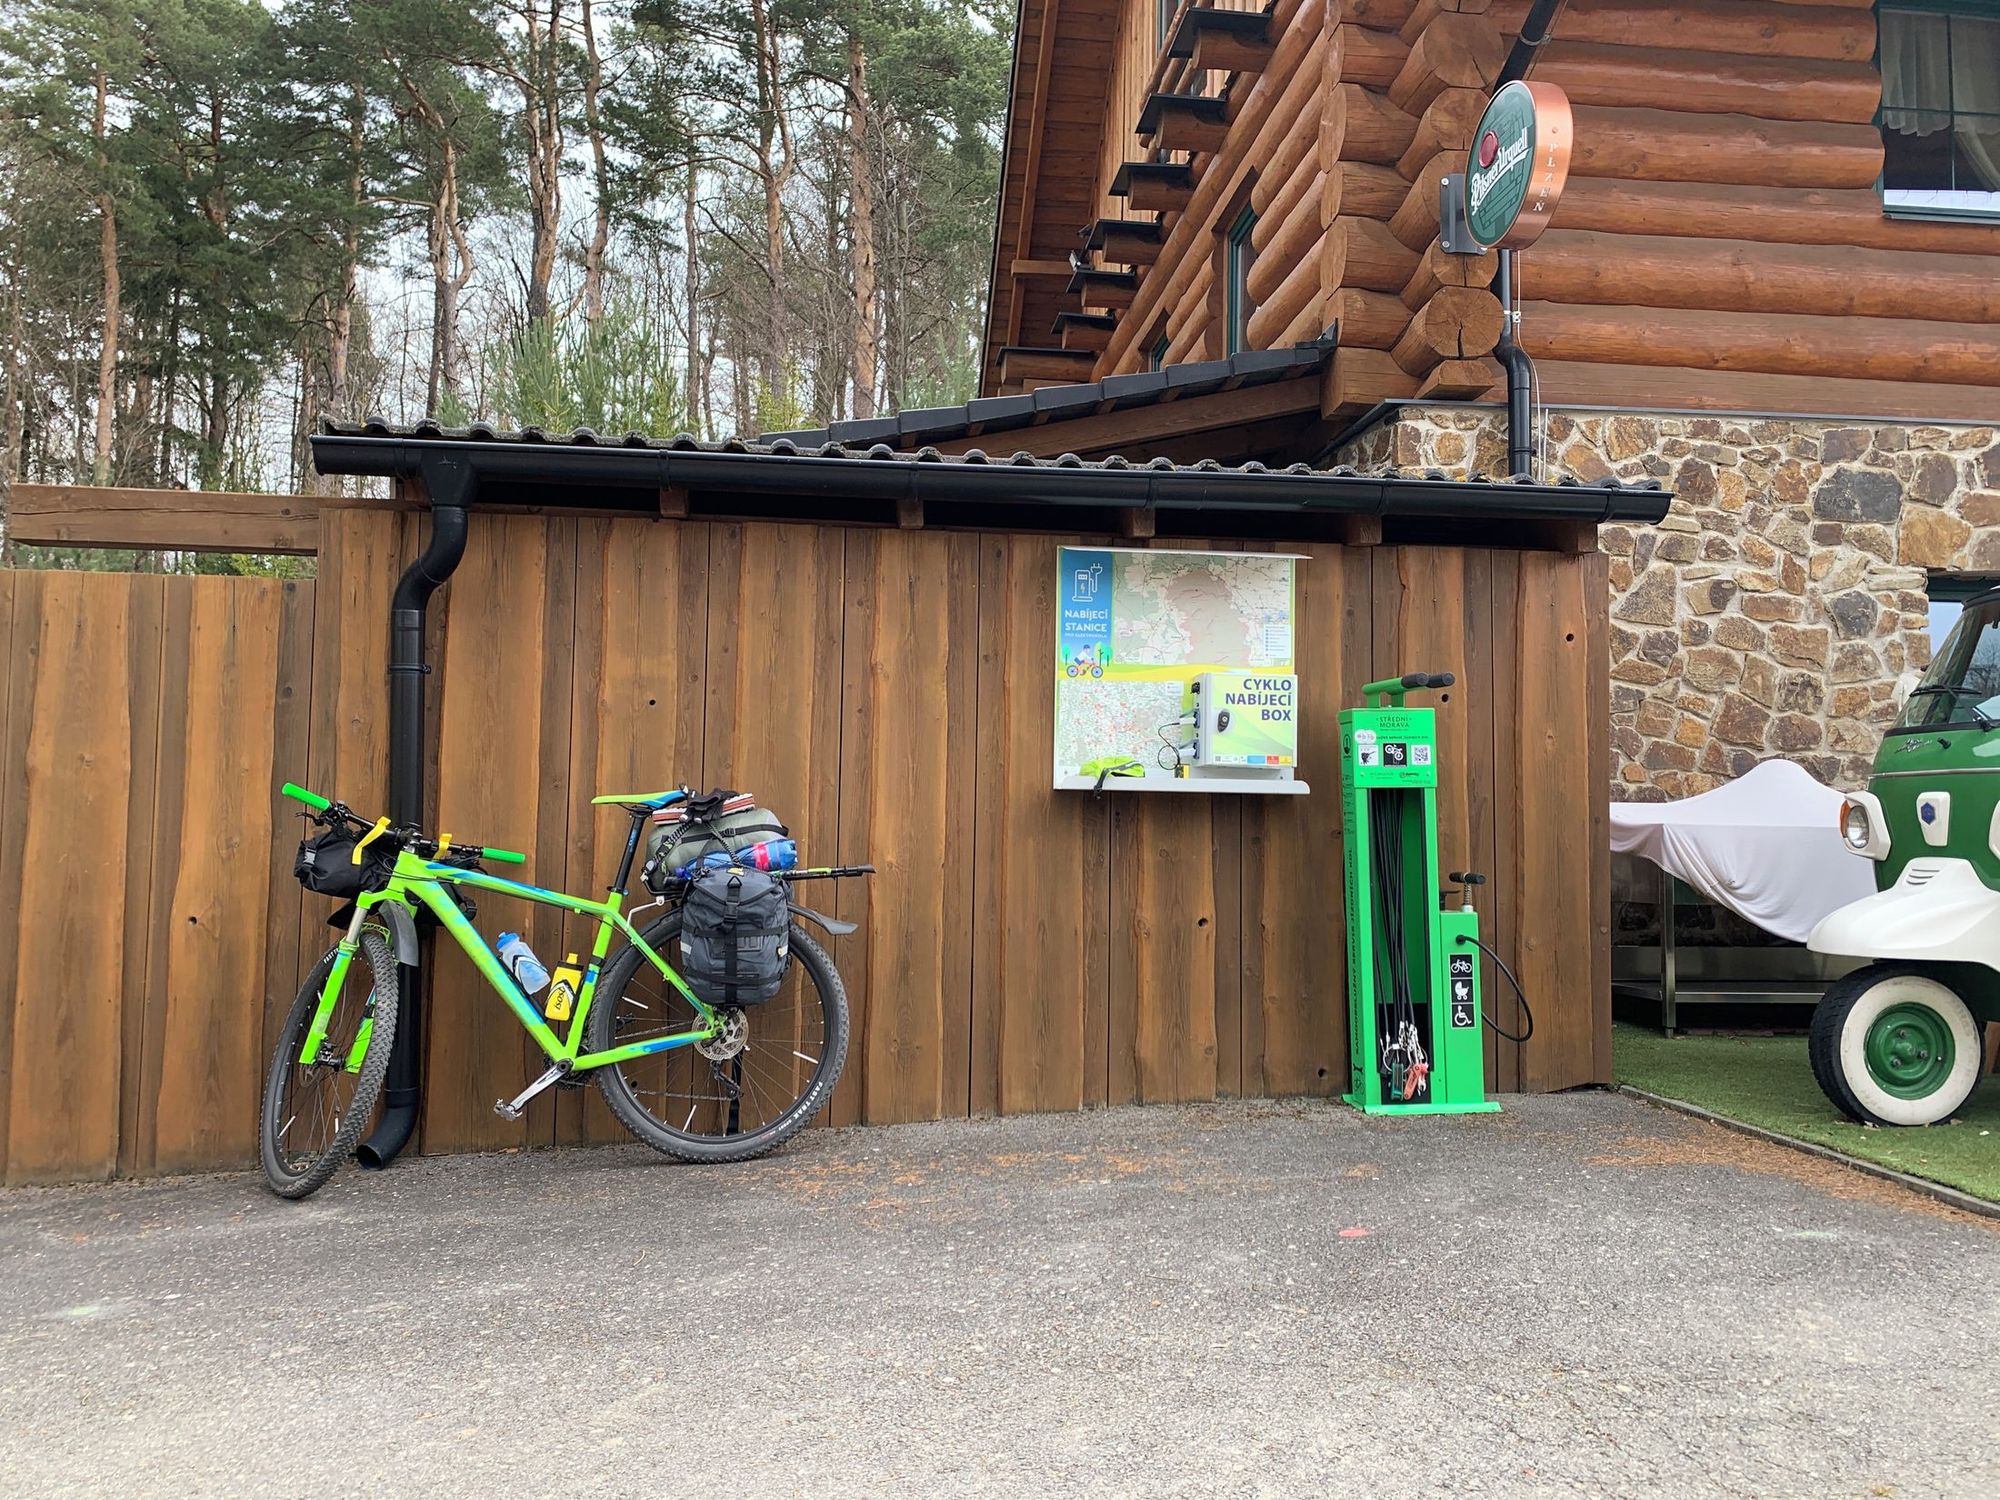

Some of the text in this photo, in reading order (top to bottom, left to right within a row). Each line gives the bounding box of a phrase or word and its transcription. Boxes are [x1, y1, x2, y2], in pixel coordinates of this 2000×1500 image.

[1471, 126, 1528, 216] Pilsner Urquell
[1064, 608, 1108, 621] NABÍJECÍ
[1065, 622, 1108, 632] STANICE
[1243, 678, 1292, 691] CYKLO
[1225, 691, 1292, 706] NABÍJECÍ
[1261, 709, 1292, 721] BOX
